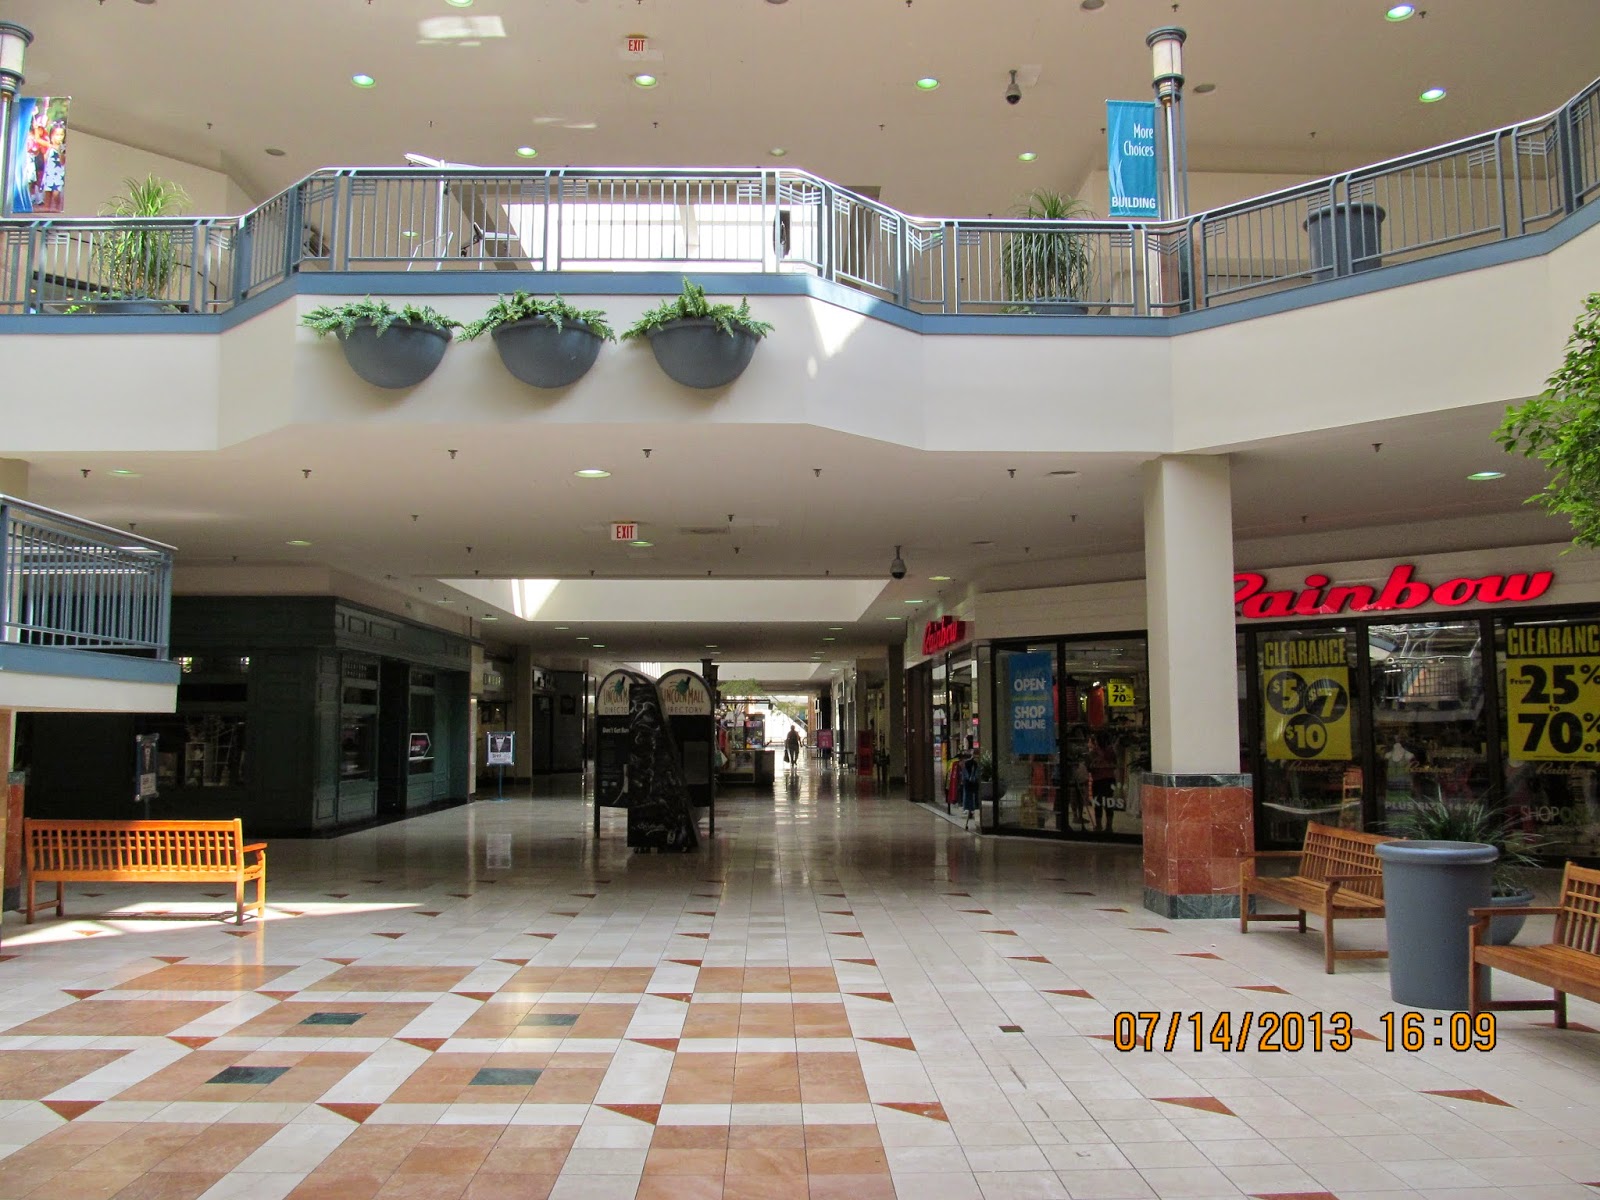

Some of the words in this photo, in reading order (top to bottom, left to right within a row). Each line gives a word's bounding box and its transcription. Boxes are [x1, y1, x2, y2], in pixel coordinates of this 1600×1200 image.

[628, 39, 645, 51] EXIT
[1133, 123, 1154, 139] More
[1123, 140, 1154, 157] Choices
[1111, 197, 1156, 209] BUILDING
[616, 525, 634, 539] EXIT
[1507, 625, 1600, 655] CLEARANC
[1264, 638, 1346, 667] CLEARANCE
[1014, 678, 1045, 692] OPEN
[1014, 705, 1046, 719] SHOP
[1014, 719, 1046, 730] ONLINE
[1285, 723, 1326, 749] $10
[1093, 796, 1125, 809] KIDS
